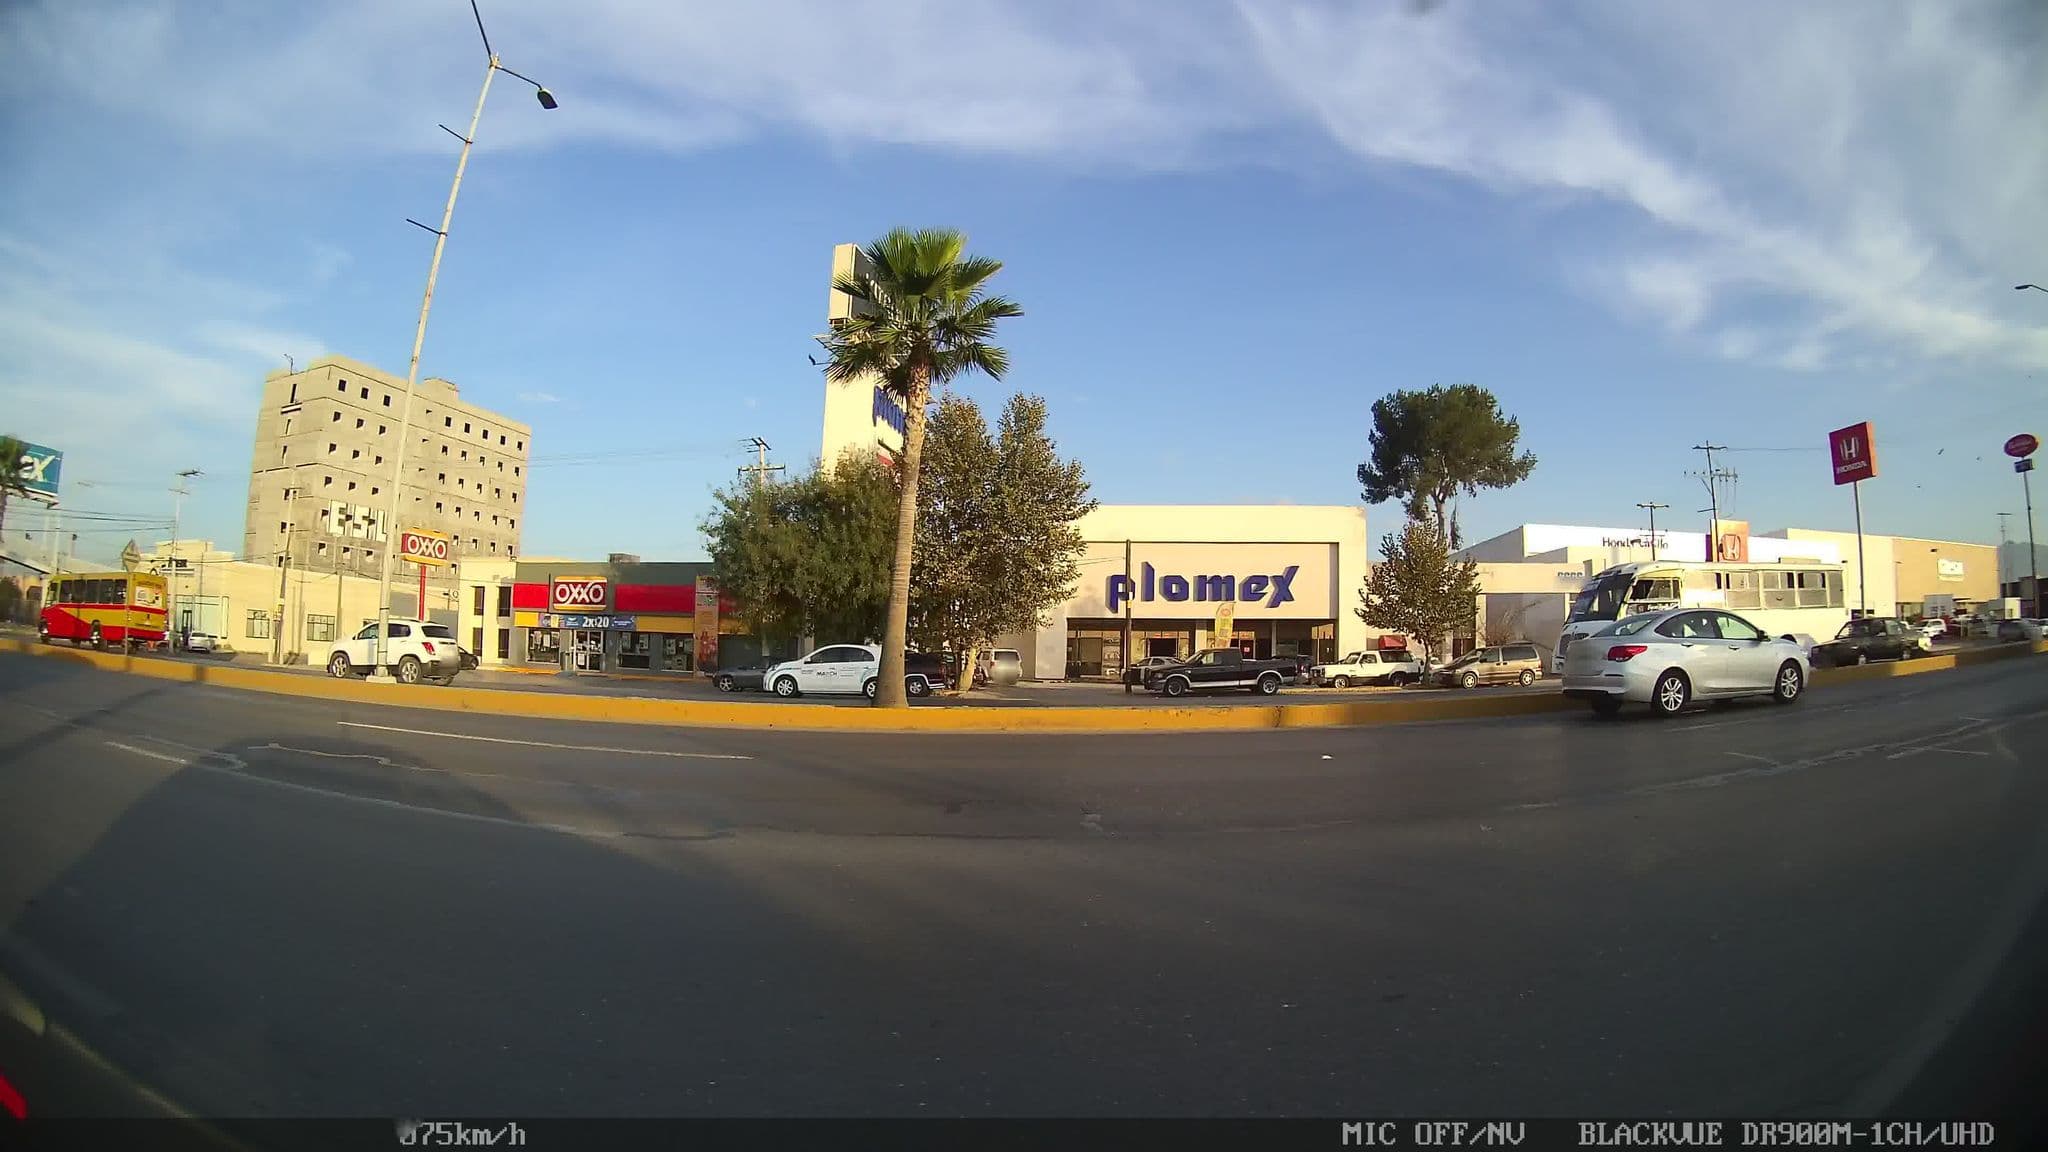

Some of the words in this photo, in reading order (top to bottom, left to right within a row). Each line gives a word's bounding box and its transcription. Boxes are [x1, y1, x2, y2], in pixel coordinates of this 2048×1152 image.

[407, 534, 447, 559] OXXO
[555, 582, 605, 605] OXXO
[1105, 561, 1300, 614] plomex
